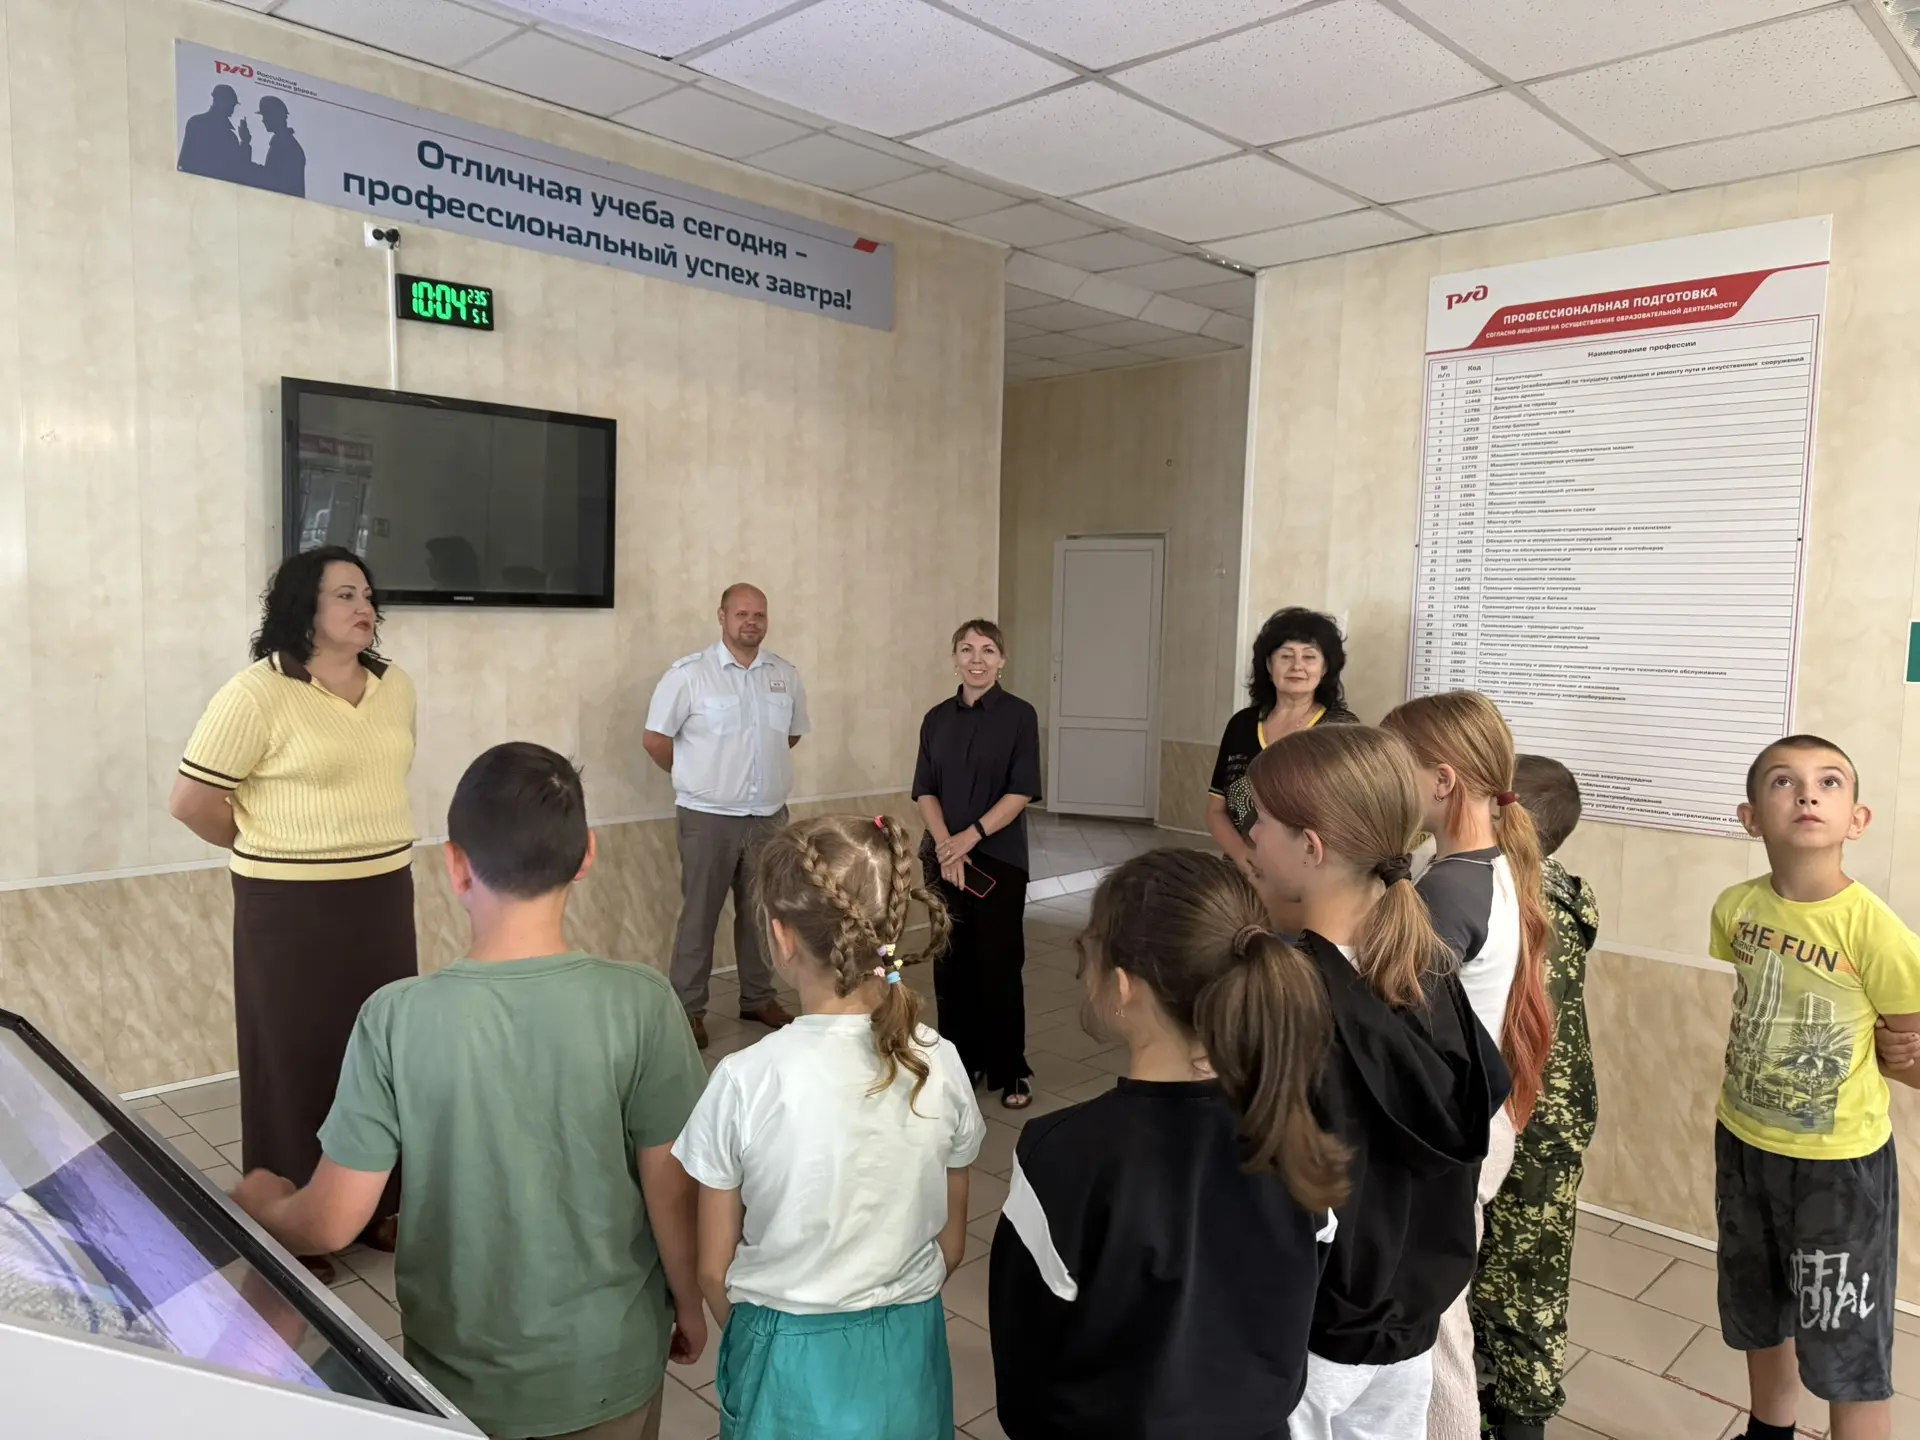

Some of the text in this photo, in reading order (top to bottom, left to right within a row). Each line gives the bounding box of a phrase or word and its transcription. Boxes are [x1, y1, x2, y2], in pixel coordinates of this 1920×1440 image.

[417, 140, 582, 205] Отличная
[591, 192, 675, 229] учеба
[683, 216, 787, 259] сегодня
[343, 172, 852, 310] профессиональный успех завтра!
[412, 281, 467, 321] 10:04
[1486, 301, 1738, 339] СОГЛАСНО ЛИЦЕНЗИИ НА ОСУЩЕСТВЛЕНИЕ ОБРАЗОВАТЕЛЬНОЙ ДЕЯТЕЛЬНОСТИ
[1503, 287, 1718, 325] ПРОФЕССИОНАЛЬНАЯ ПОДГОТОВКА
[1588, 340, 1697, 358] Наименование профессии
[1679, 668, 1727, 677] обслуживания
[1738, 921, 1839, 973] THE FUN
